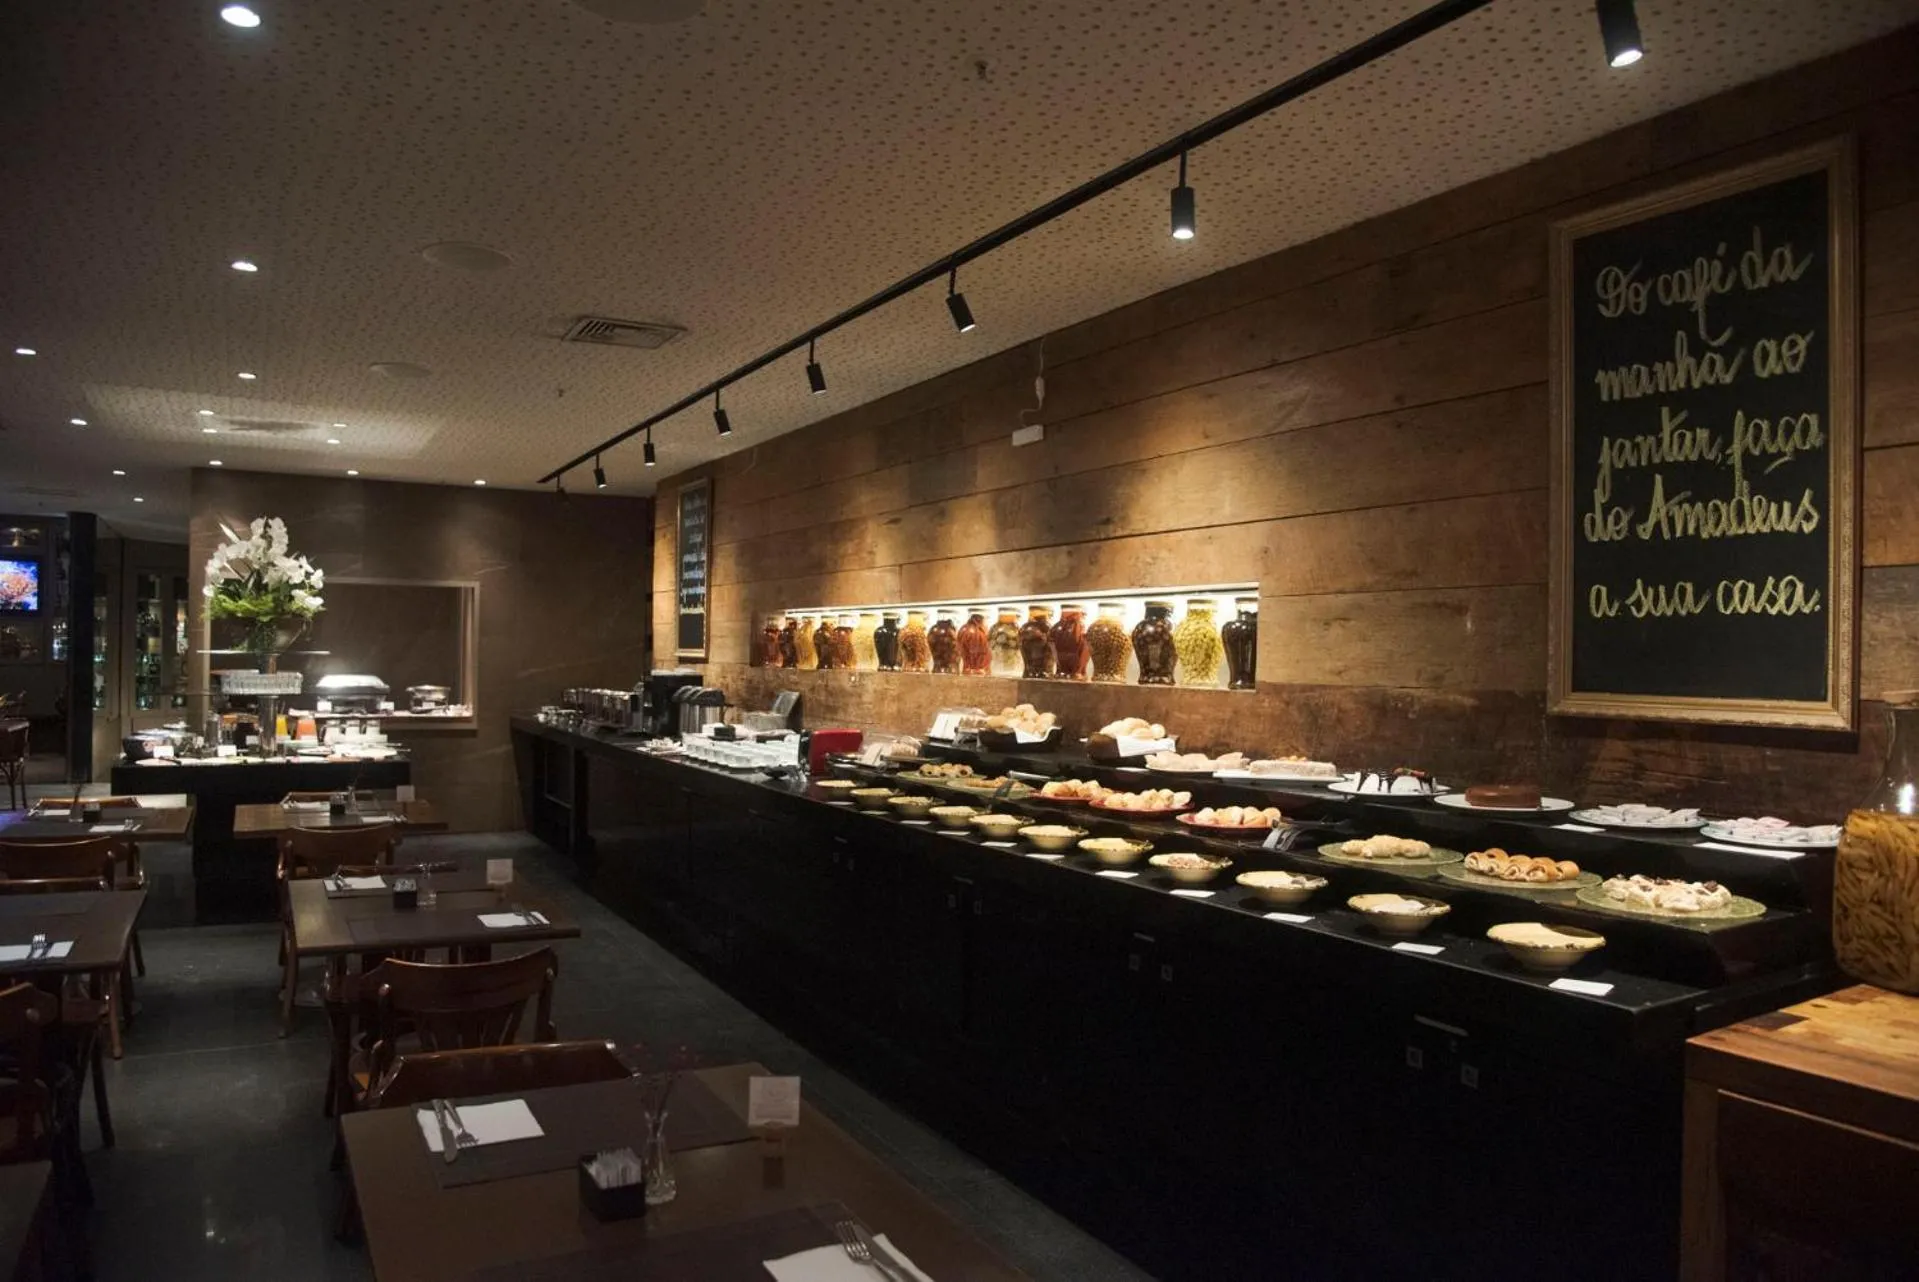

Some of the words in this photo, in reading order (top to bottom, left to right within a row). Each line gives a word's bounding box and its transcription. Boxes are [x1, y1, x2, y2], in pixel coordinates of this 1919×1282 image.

[1596, 259, 1653, 318] Do
[1657, 241, 1737, 347] café
[1740, 225, 1814, 290] da
[1753, 330, 1815, 378] ao
[1725, 409, 1824, 497] faça
[1584, 488, 1634, 542] do
[1636, 474, 1820, 540] Amadeus
[1589, 583, 1620, 618] a
[1625, 577, 1711, 618] sua
[1716, 574, 1821, 617] casa.
